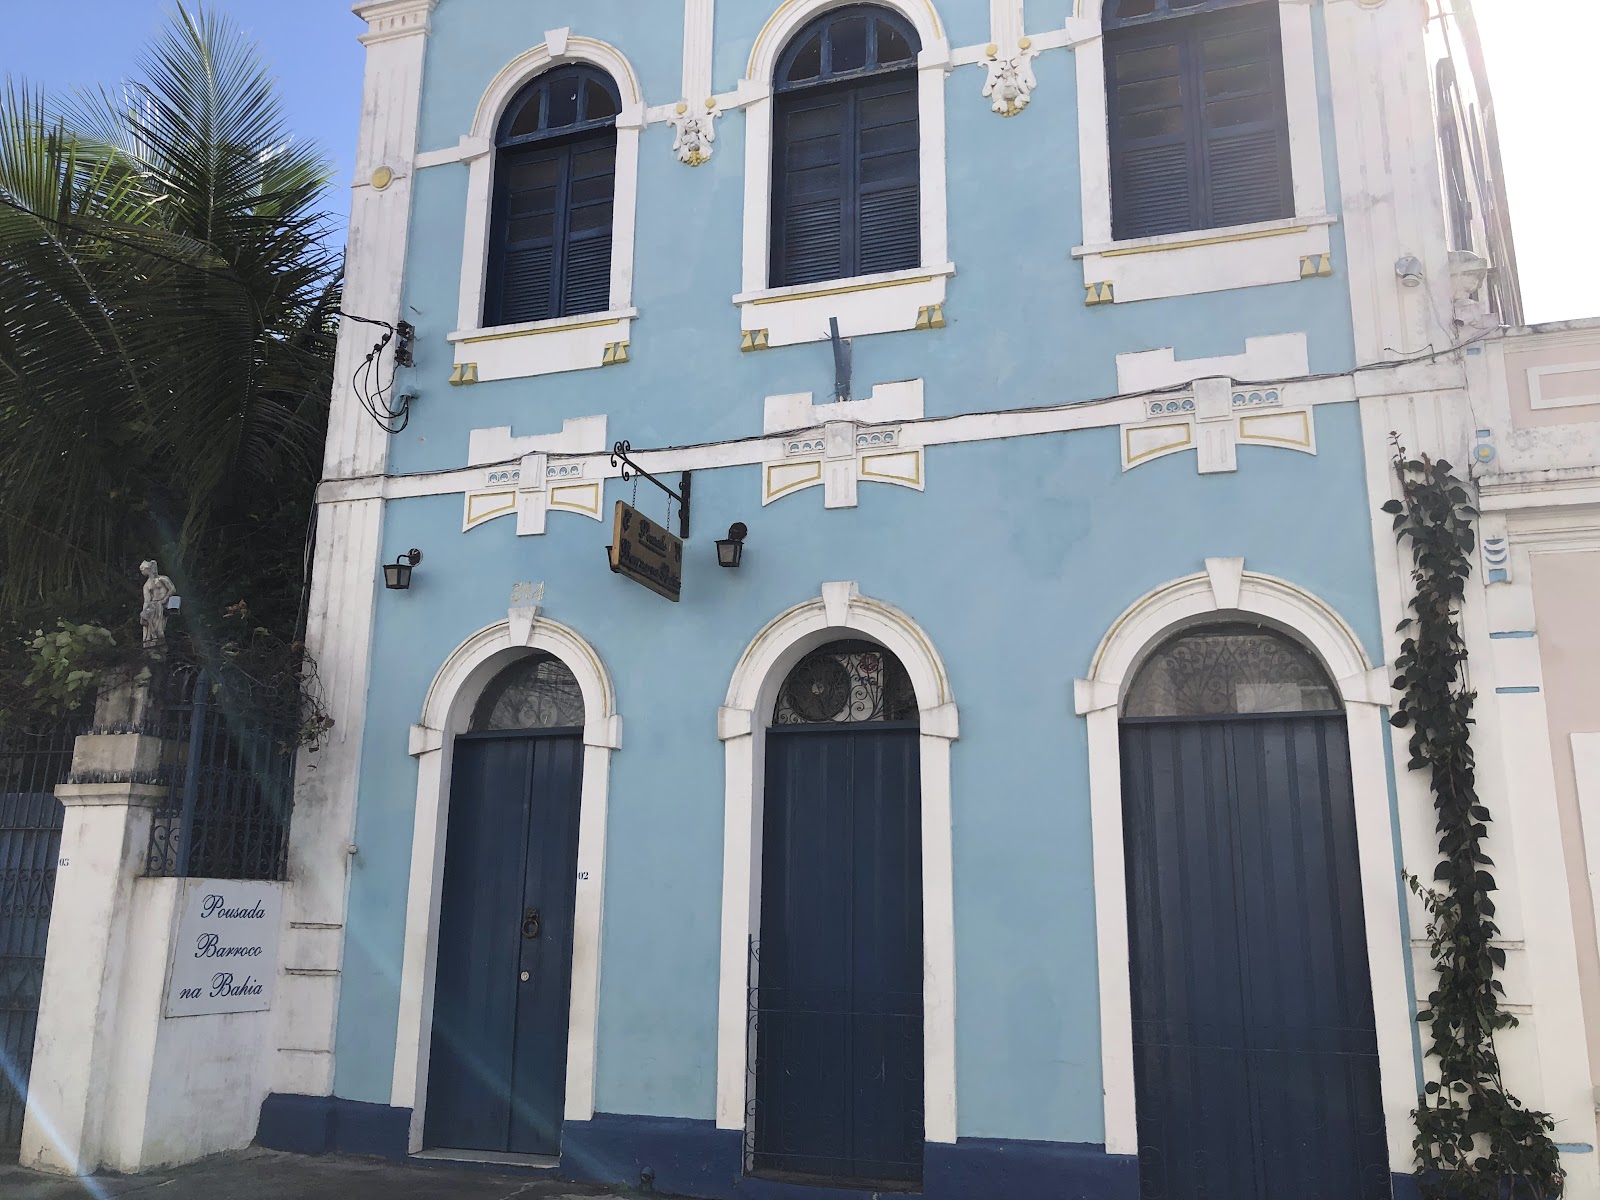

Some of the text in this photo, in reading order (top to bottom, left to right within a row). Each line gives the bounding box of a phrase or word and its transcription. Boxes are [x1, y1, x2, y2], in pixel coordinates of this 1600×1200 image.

[578, 871, 589, 880] 02
[201, 894, 266, 919] Pousada
[194, 932, 262, 958] Barroco
[180, 972, 263, 999] na Bahia
